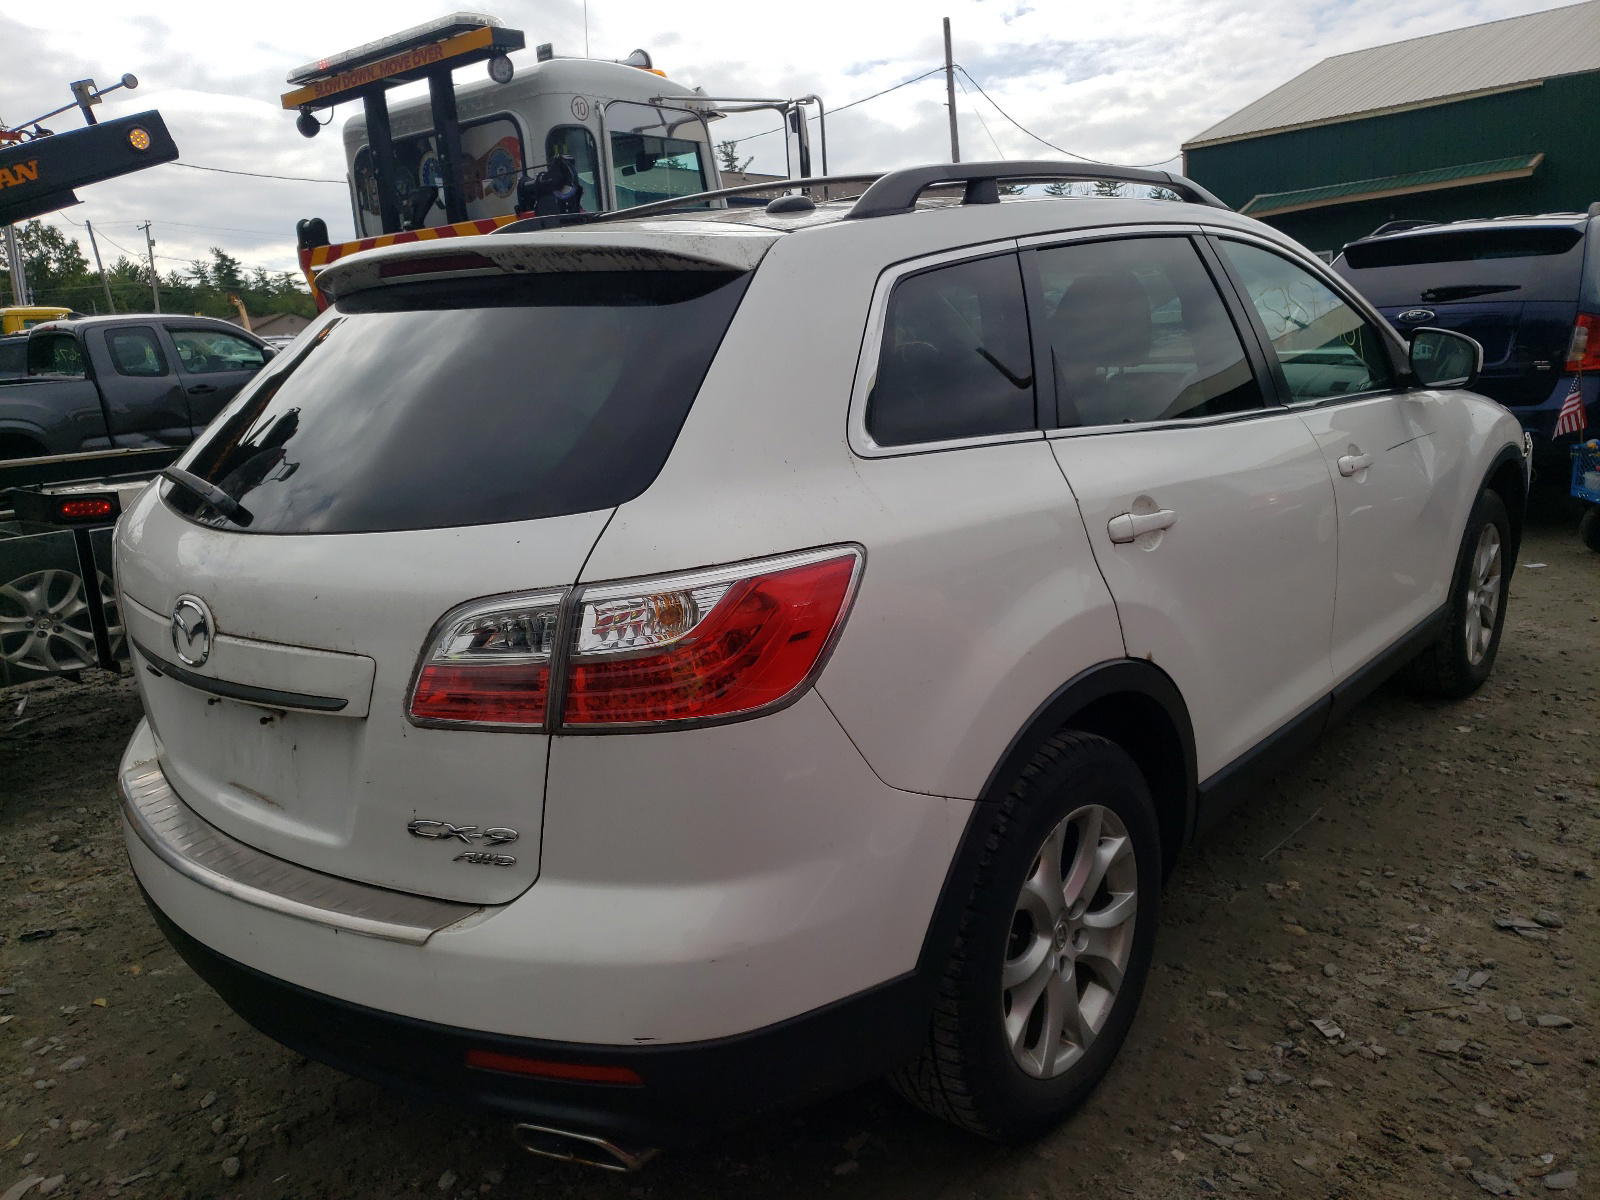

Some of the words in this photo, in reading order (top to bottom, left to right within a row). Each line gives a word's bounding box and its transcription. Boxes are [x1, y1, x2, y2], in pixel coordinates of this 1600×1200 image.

[314, 79, 342, 97] SLOW
[380, 56, 411, 75] MOVE
[413, 45, 442, 64] OVER
[575, 102, 586, 115] 10
[407, 819, 519, 846] CX-9
[452, 851, 516, 866] AWD
